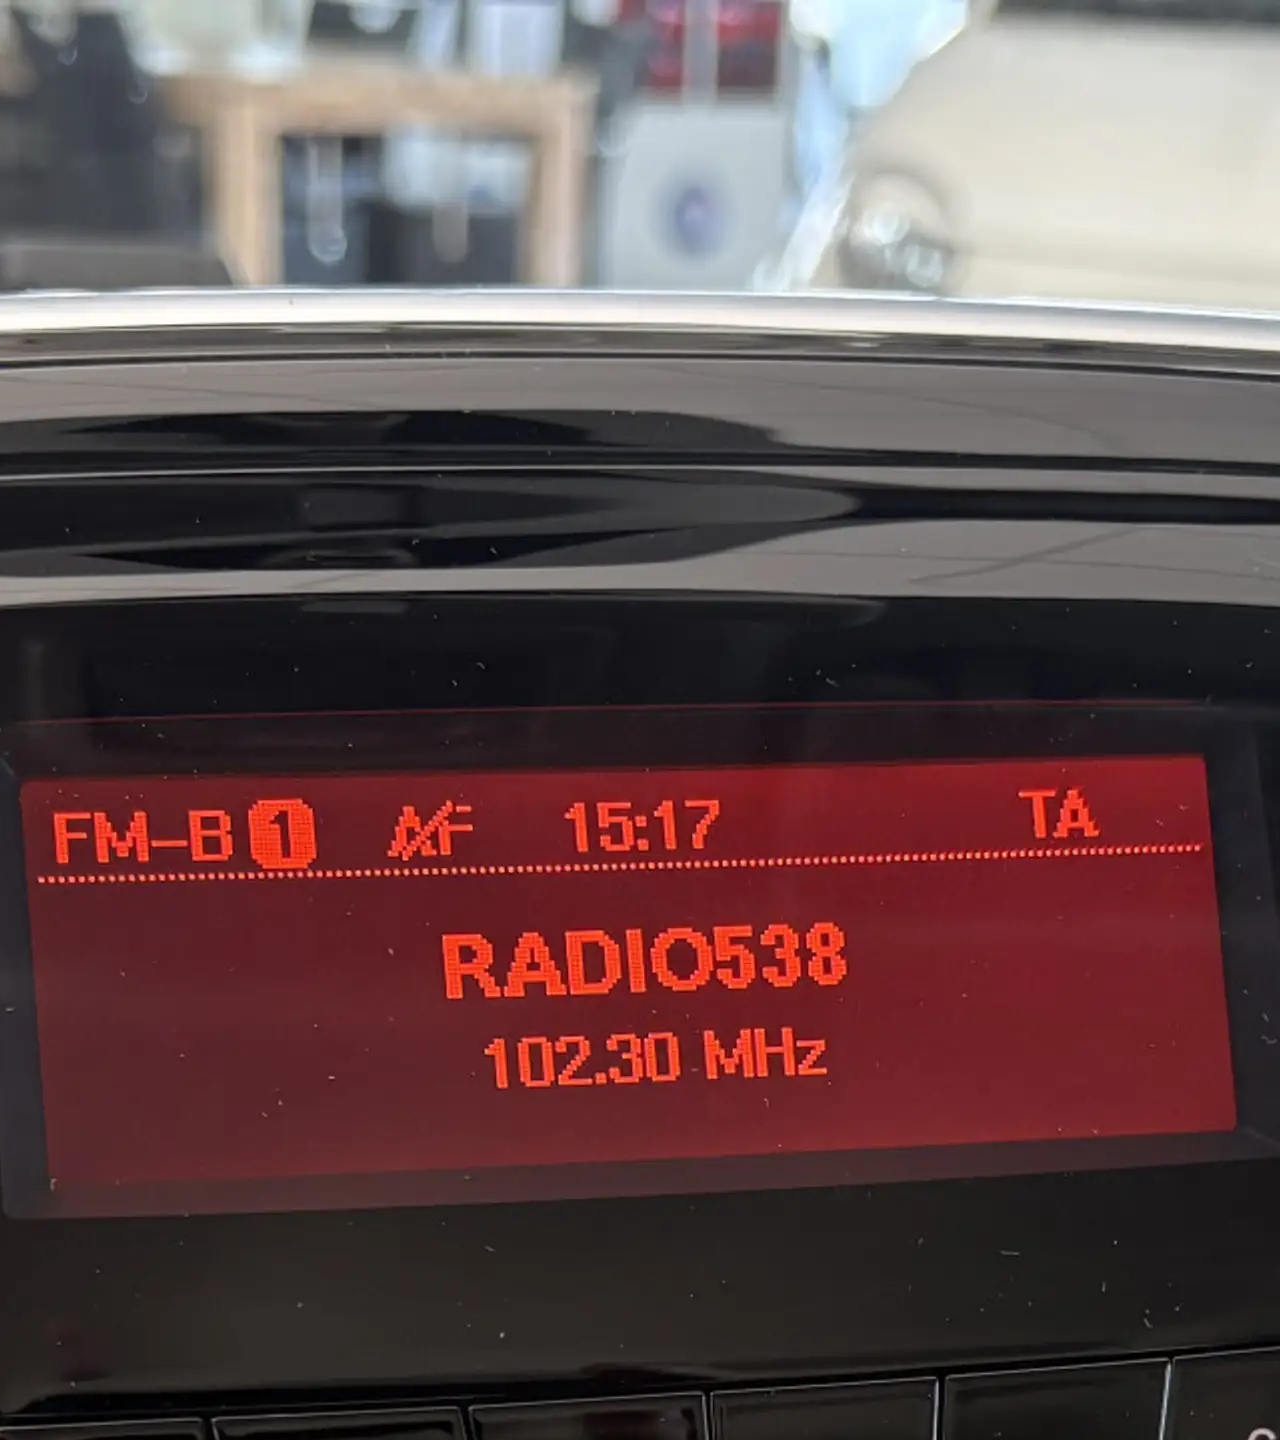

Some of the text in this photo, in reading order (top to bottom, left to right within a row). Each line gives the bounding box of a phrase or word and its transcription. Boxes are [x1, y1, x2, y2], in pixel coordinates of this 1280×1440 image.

[564, 799, 720, 853] 15:17
[1018, 788, 1100, 839] TA
[442, 922, 847, 1000] RADIO538
[484, 1027, 828, 1089] 102.30 MHz
